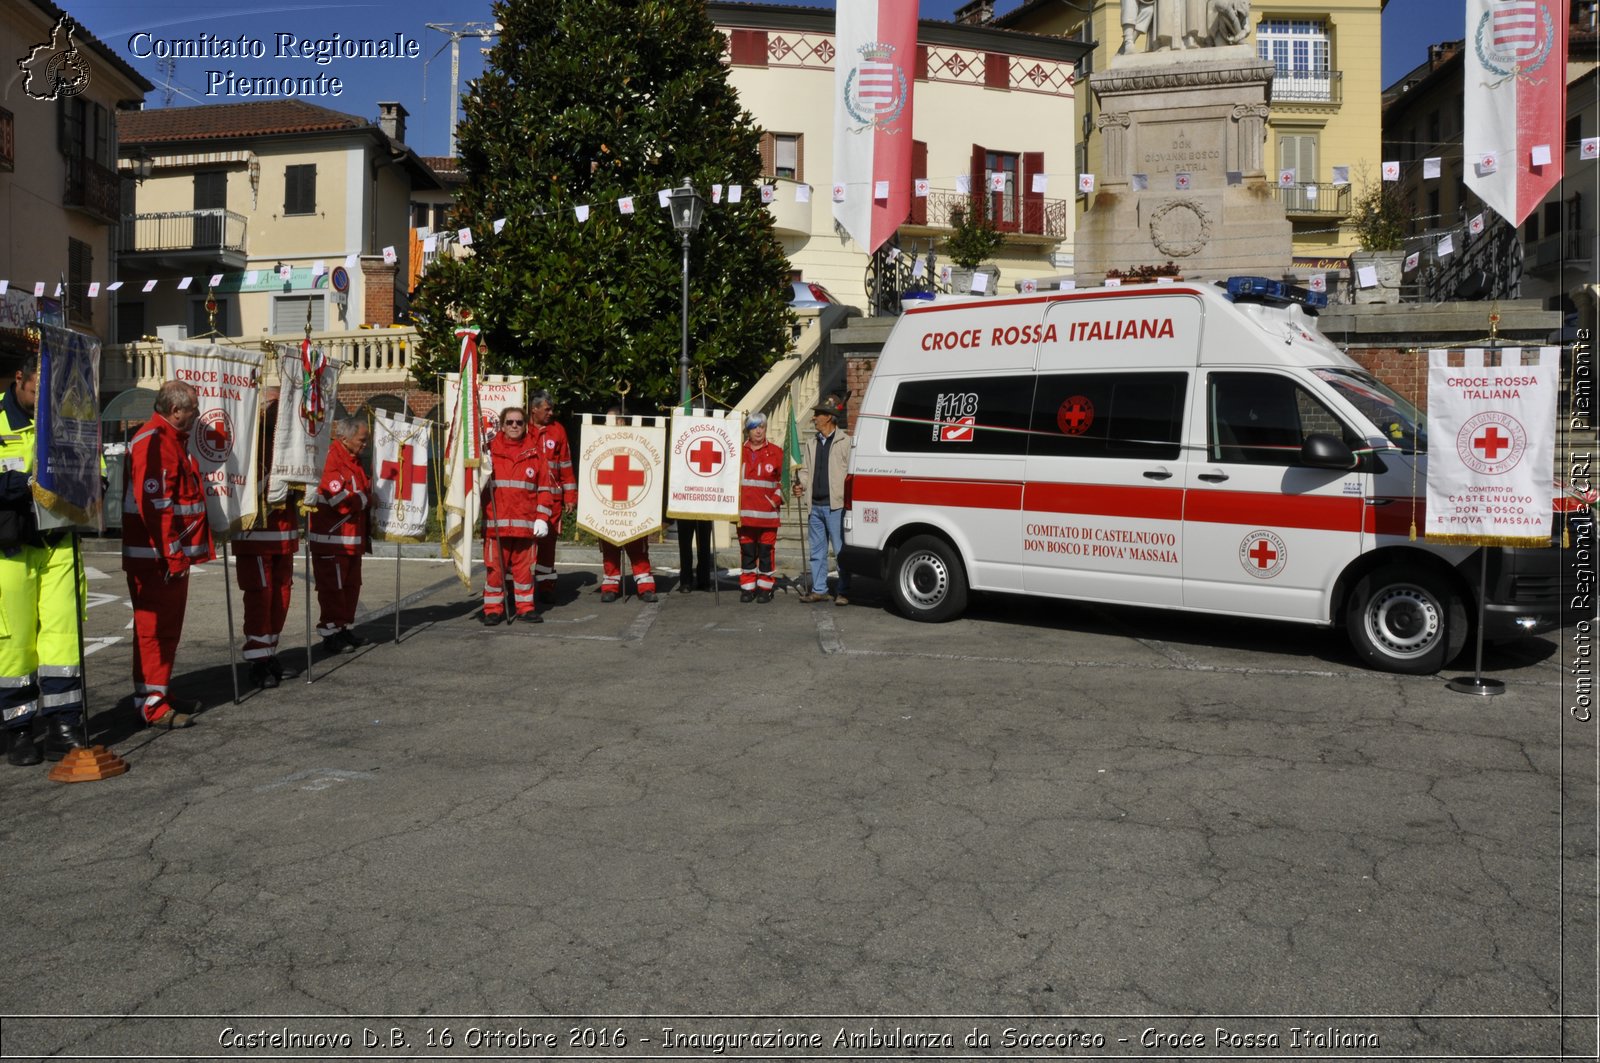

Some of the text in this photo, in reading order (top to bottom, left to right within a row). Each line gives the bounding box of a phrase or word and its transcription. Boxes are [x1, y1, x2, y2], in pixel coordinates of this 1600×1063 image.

[921, 318, 1175, 351] CROCE ROSSA ITALIANA
[176, 369, 217, 383] CROCE
[1447, 376, 1538, 388] CROCE ROSSA
[488, 384, 517, 392] ROSSA
[1463, 389, 1521, 400] ITALIANA
[943, 392, 978, 417] 118
[674, 424, 737, 458] CROCE ROSSA ITALIANA
[582, 431, 662, 467] CROCE ROSSA ITALIANA
[672, 493, 735, 503] MONTEGROSSO D'ASTI
[1448, 495, 1532, 504] CASTELNUOVO
[602, 509, 637, 517] COMITATO
[1456, 506, 1524, 514] DON BOSCO
[585, 513, 627, 538] VILLANOVA
[605, 519, 633, 527] LOCALE
[1494, 517, 1542, 525] MASSAIA
[1026, 523, 1176, 547] COMITATO DI CASTELNUOVO
[1024, 539, 1178, 564] DON BOSCO E PIOVA' MASSAIA
